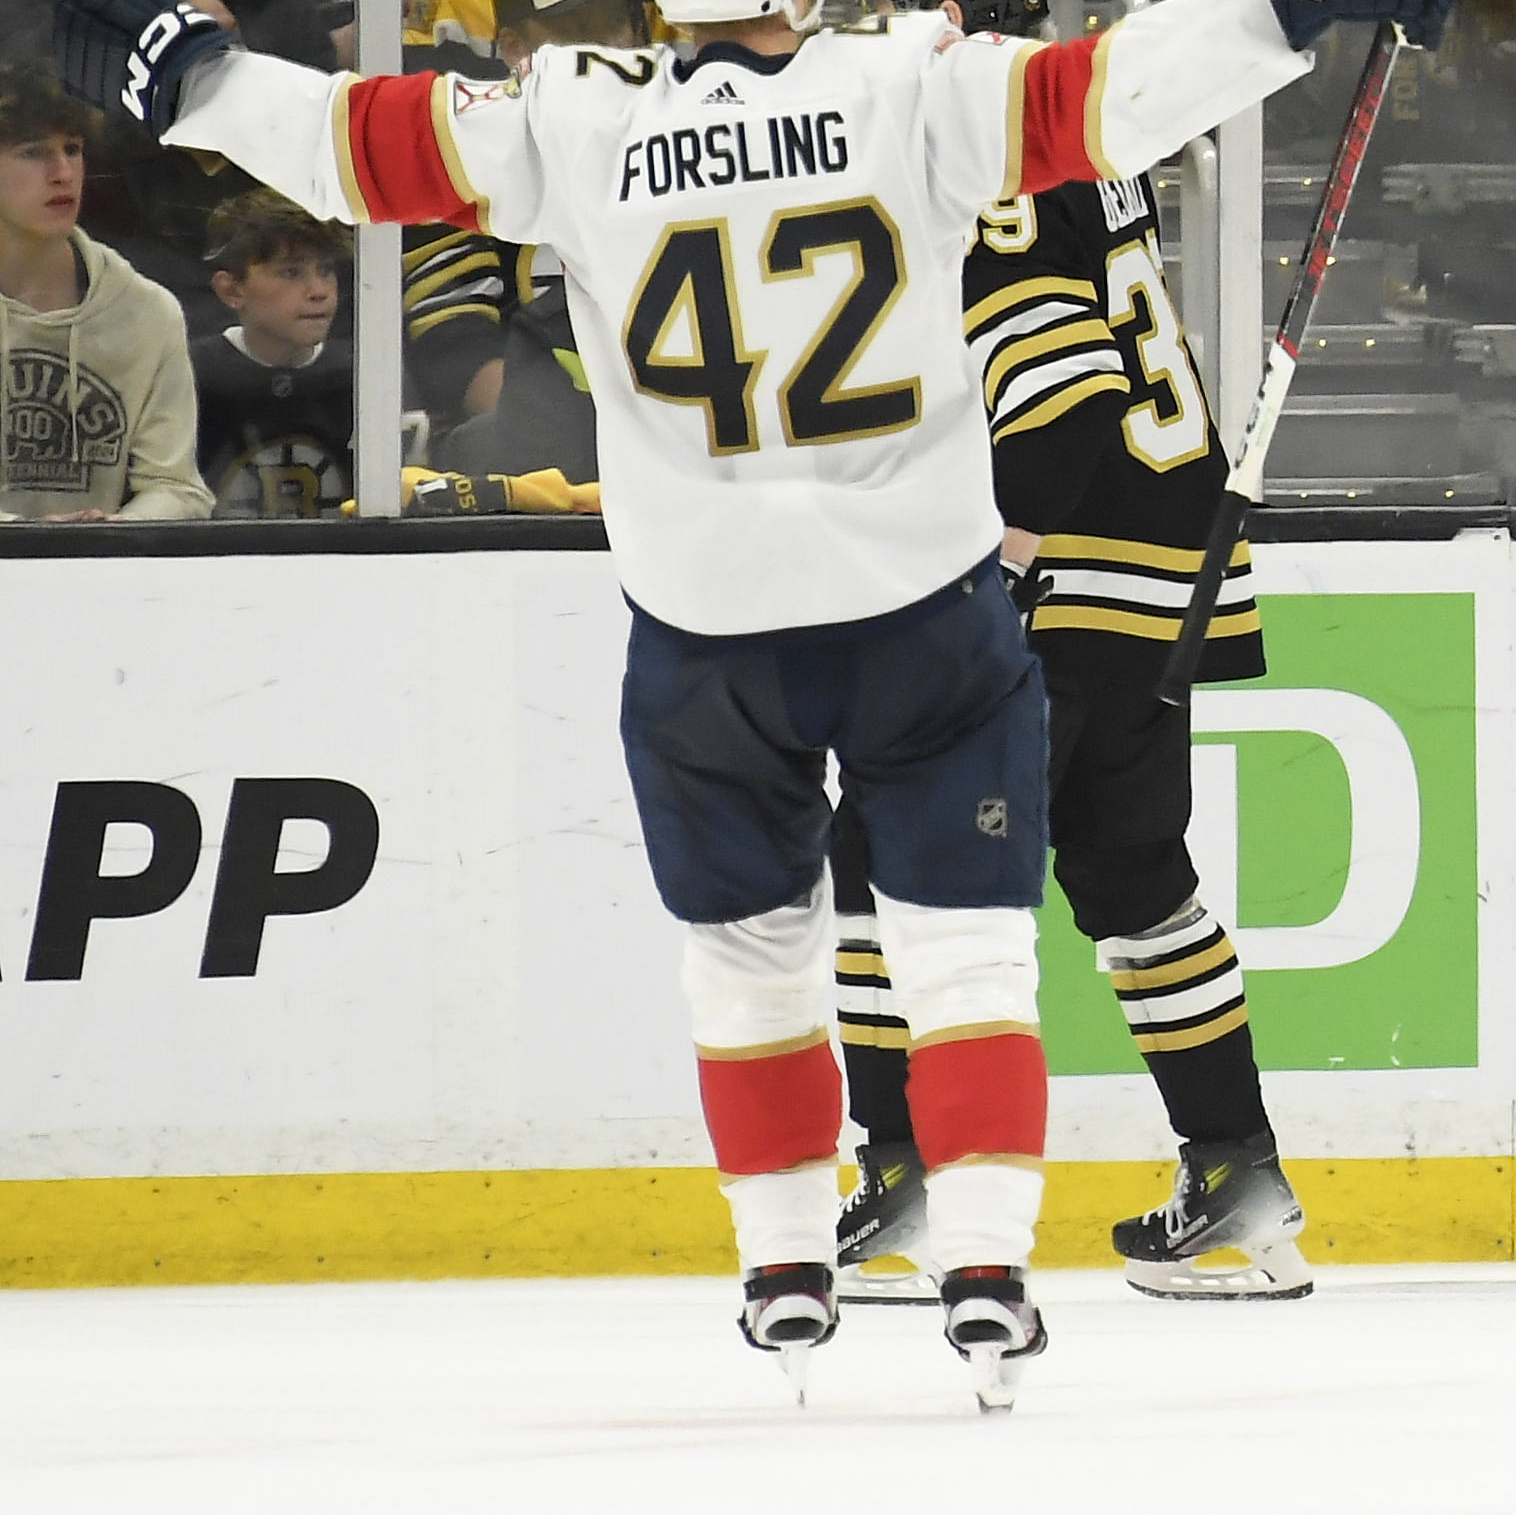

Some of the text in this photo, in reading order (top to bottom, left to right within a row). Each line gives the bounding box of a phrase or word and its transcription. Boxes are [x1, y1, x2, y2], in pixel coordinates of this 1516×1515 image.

[620, 111, 847, 201] FORSLING
[967, 191, 1040, 256] 9
[7, 357, 105, 441] UINS
[620, 195, 922, 457] 42
[1100, 226, 1212, 476] 3
[0, 777, 379, 982] PP
